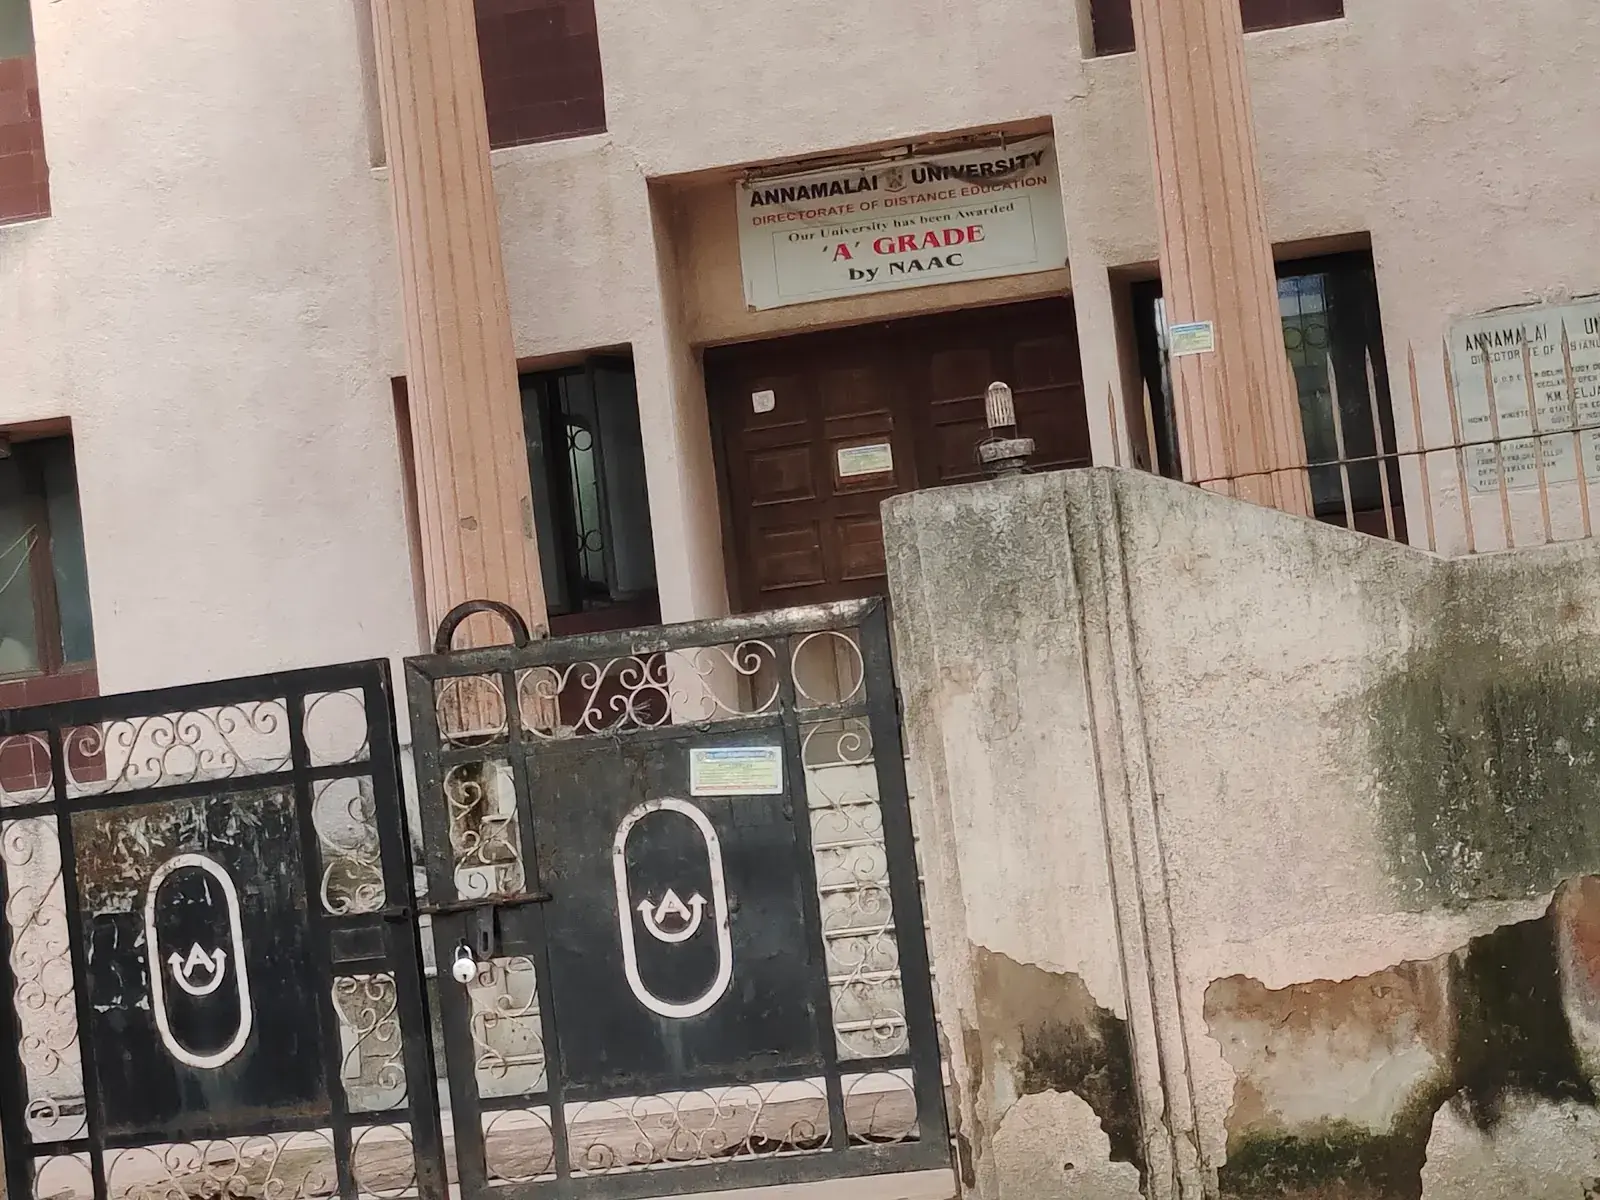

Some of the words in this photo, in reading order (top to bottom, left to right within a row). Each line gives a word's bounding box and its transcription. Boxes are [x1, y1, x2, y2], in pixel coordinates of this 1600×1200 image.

[751, 175, 878, 207] ANNAMALAI
[911, 151, 1044, 184] UNIVERSITY
[752, 204, 854, 226] DIRECTORATE
[860, 201, 879, 211] OF
[884, 190, 957, 207] DISTANCE
[961, 176, 1048, 197] EDUCATION
[788, 231, 816, 243] Our
[820, 221, 889, 239] University
[893, 218, 915, 229] has
[920, 214, 951, 224] been
[955, 202, 1014, 219] Awarded
[873, 224, 986, 255] GRADE
[848, 265, 879, 282] by
[889, 253, 964, 276] NAAC
